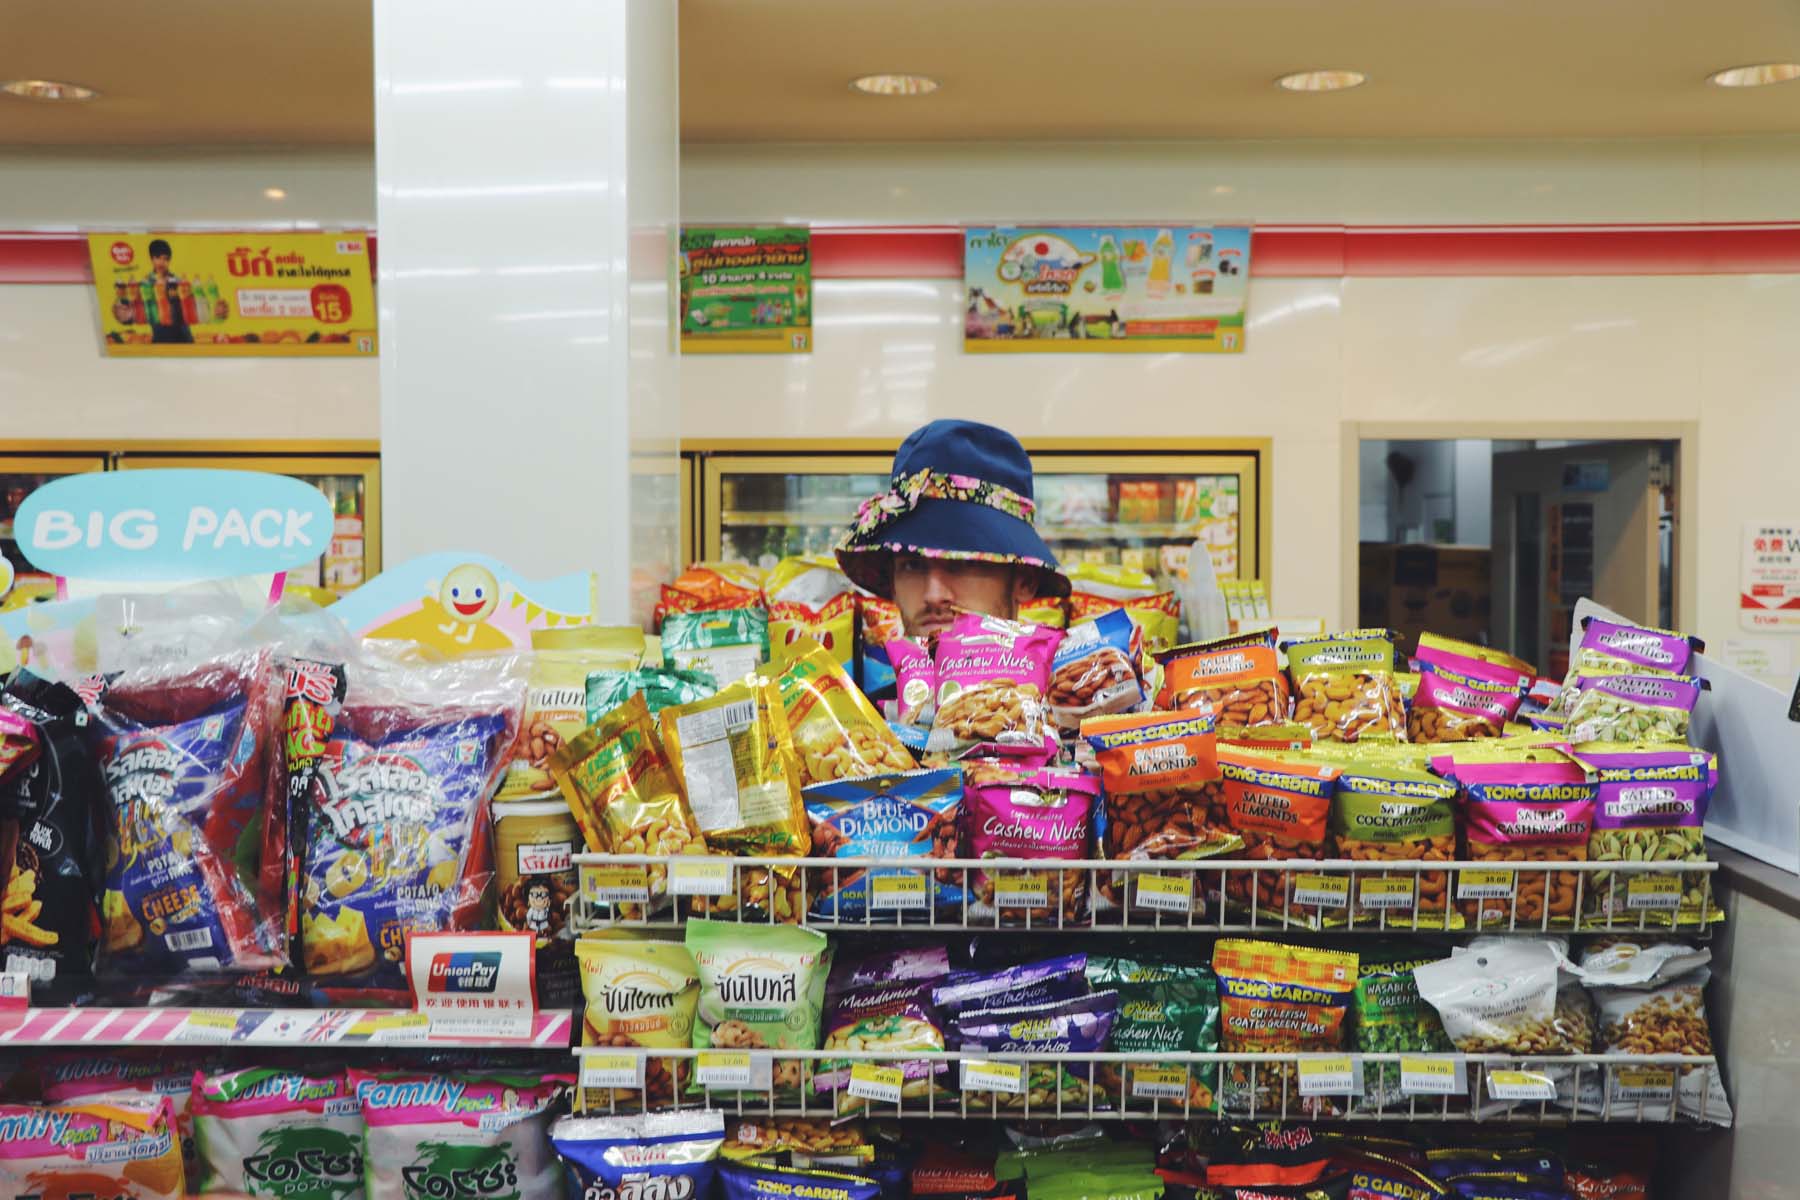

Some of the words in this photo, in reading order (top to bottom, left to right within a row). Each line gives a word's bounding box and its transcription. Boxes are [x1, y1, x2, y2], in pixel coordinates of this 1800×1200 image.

[316, 301, 344, 322] 15
[32, 508, 158, 551] BIG
[182, 505, 314, 552] PACK
[999, 651, 1036, 671] Nuts
[1100, 728, 1147, 749] TONG
[1146, 718, 1209, 740] GARDEN
[1134, 743, 1187, 762] SALTED
[1128, 755, 1199, 777] ALMONDS
[1633, 766, 1700, 781] GARDEN
[1218, 762, 1257, 783] TONG
[1257, 771, 1320, 796] GARDEN
[1350, 776, 1392, 793] TONG
[1243, 790, 1290, 810] SALTED
[1483, 785, 1527, 801] TONG
[1528, 785, 1591, 801] GARDEN
[1620, 787, 1676, 801] SALTED
[863, 798, 907, 820] BLUE
[1233, 800, 1298, 825] ALMONDS
[1516, 808, 1567, 821] SALTED
[1604, 800, 1695, 818] PISTACHIOS
[840, 812, 929, 839] DIAMOND
[983, 815, 1045, 840] Cashew
[1049, 820, 1086, 841] Nuts
[1497, 822, 1552, 835] CASHEW
[1554, 822, 1586, 833] NUTS
[432, 961, 497, 981] UnionPay
[1226, 980, 1269, 998] TONG
[1270, 985, 1333, 1004] GARDEN
[1250, 1007, 1308, 1020] CUTTLEFISH
[1110, 1023, 1153, 1041] ashew
[1152, 1023, 1184, 1042] Nuts
[1229, 1016, 1266, 1029] COATED
[1266, 1018, 1299, 1030] GREEN
[1300, 1022, 1326, 1034] PEAS
[298, 1080, 337, 1101] Pack
[356, 1074, 465, 1113] Family
[0, 1109, 73, 1145] mily
[61, 1124, 102, 1147] Pack
